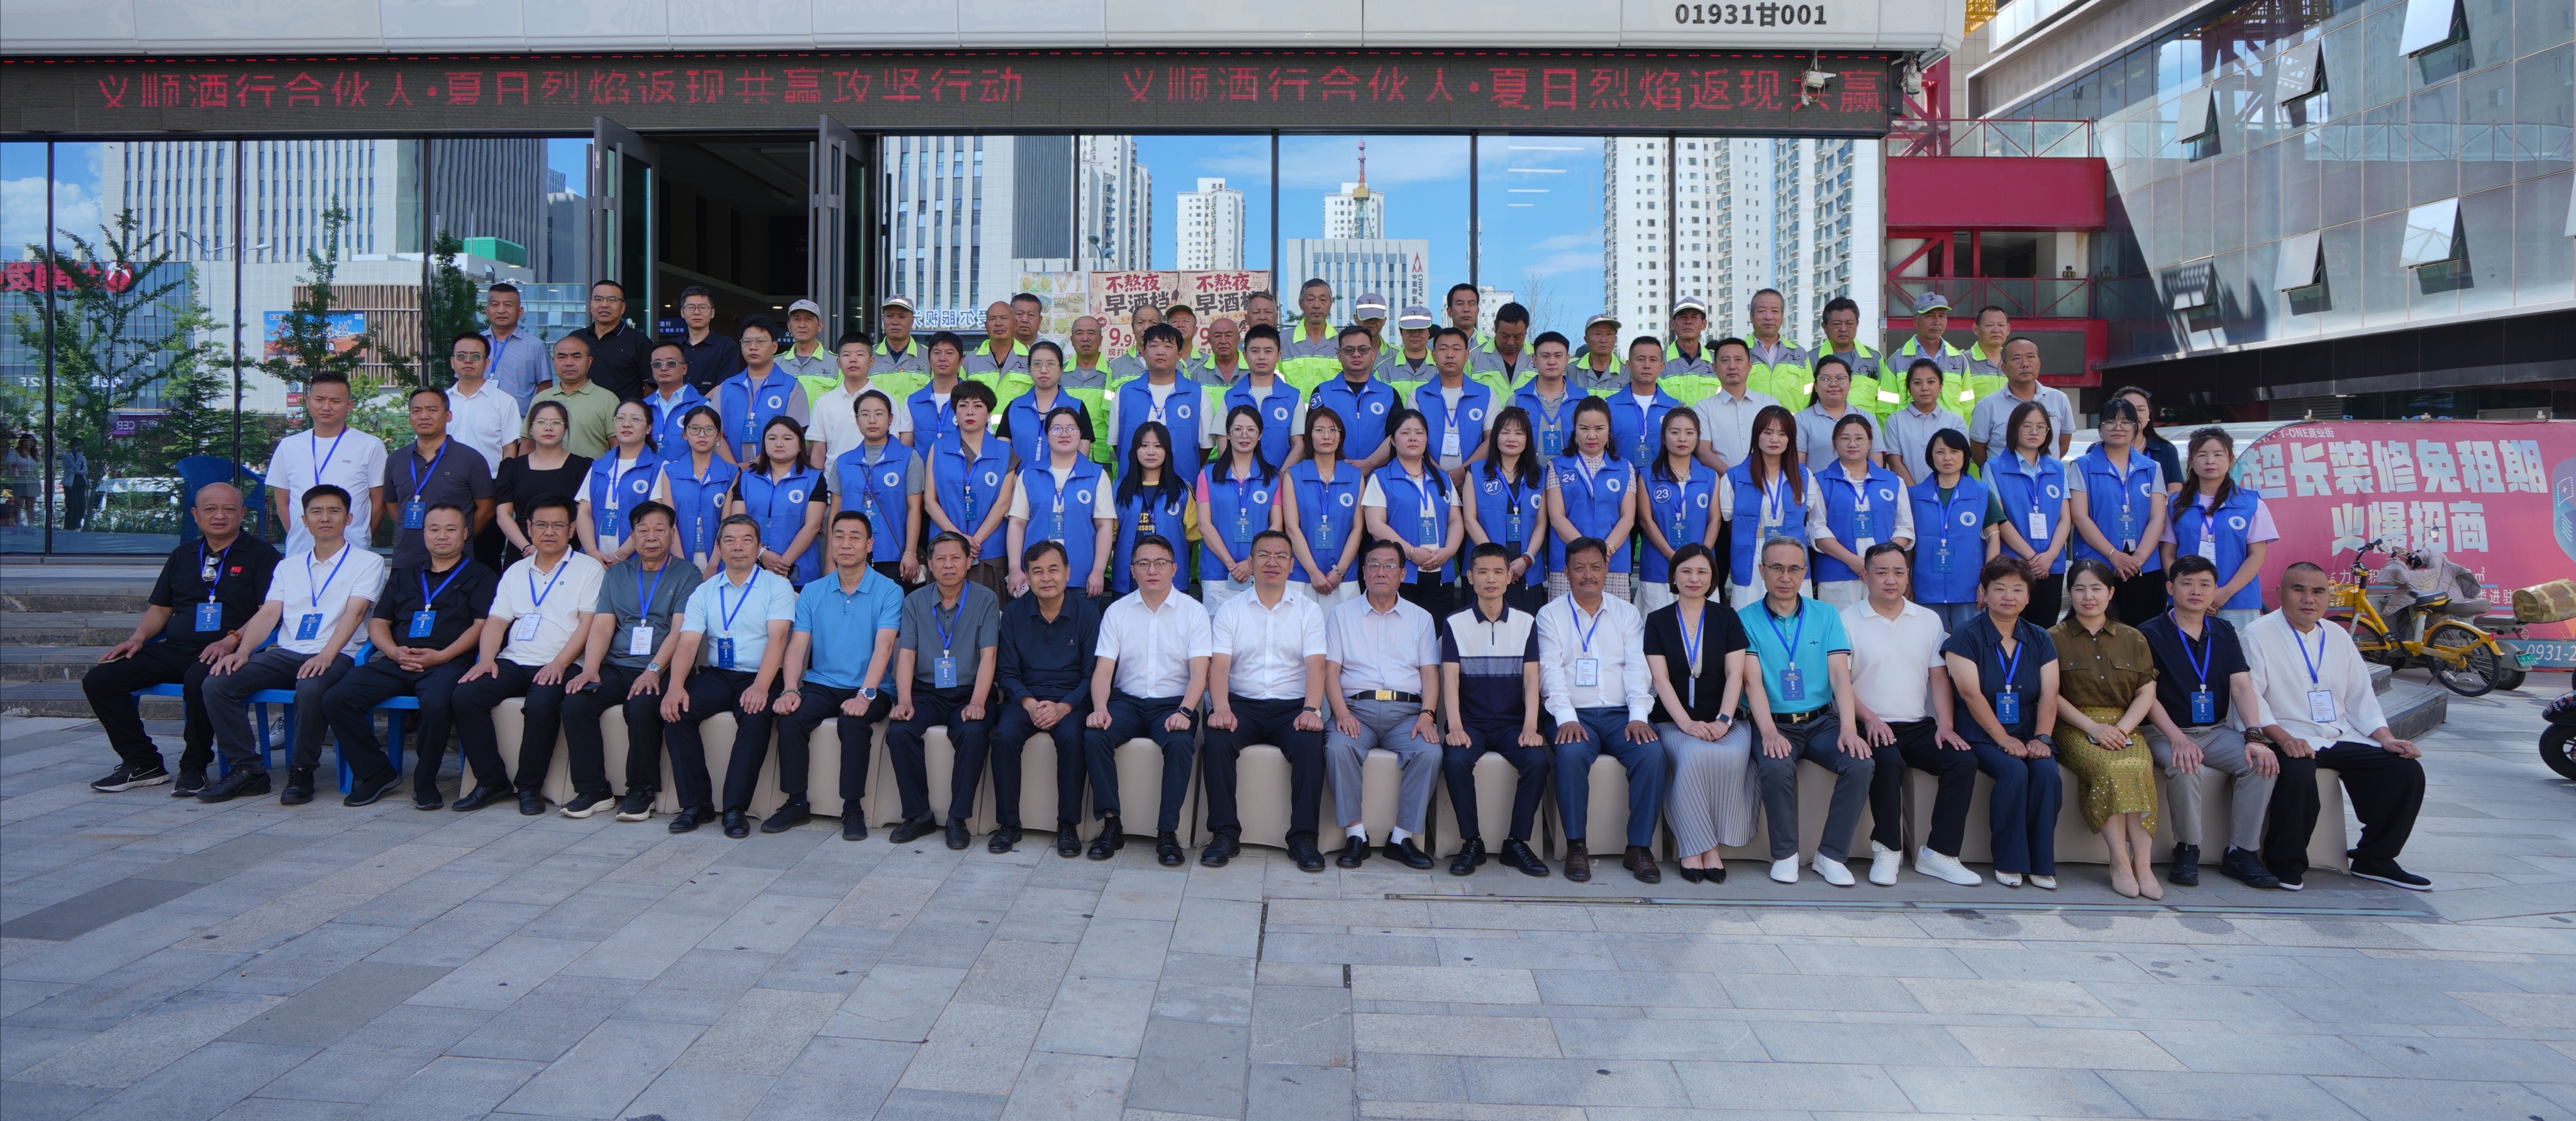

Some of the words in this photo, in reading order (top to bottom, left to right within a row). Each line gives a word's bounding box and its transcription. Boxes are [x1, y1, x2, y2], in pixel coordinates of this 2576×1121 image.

[1675, 3, 1827, 26] 01931甘001
[1106, 274, 1160, 293] 不熬夜
[1196, 273, 1251, 293] 不熬夜
[1311, 394, 1322, 407] 31
[1562, 473, 1576, 483] 24
[2242, 439, 2549, 499] 超长装修免租期
[1485, 481, 1499, 492] 27
[1656, 489, 1669, 499] 23
[2331, 501, 2489, 557] 火爆招商
